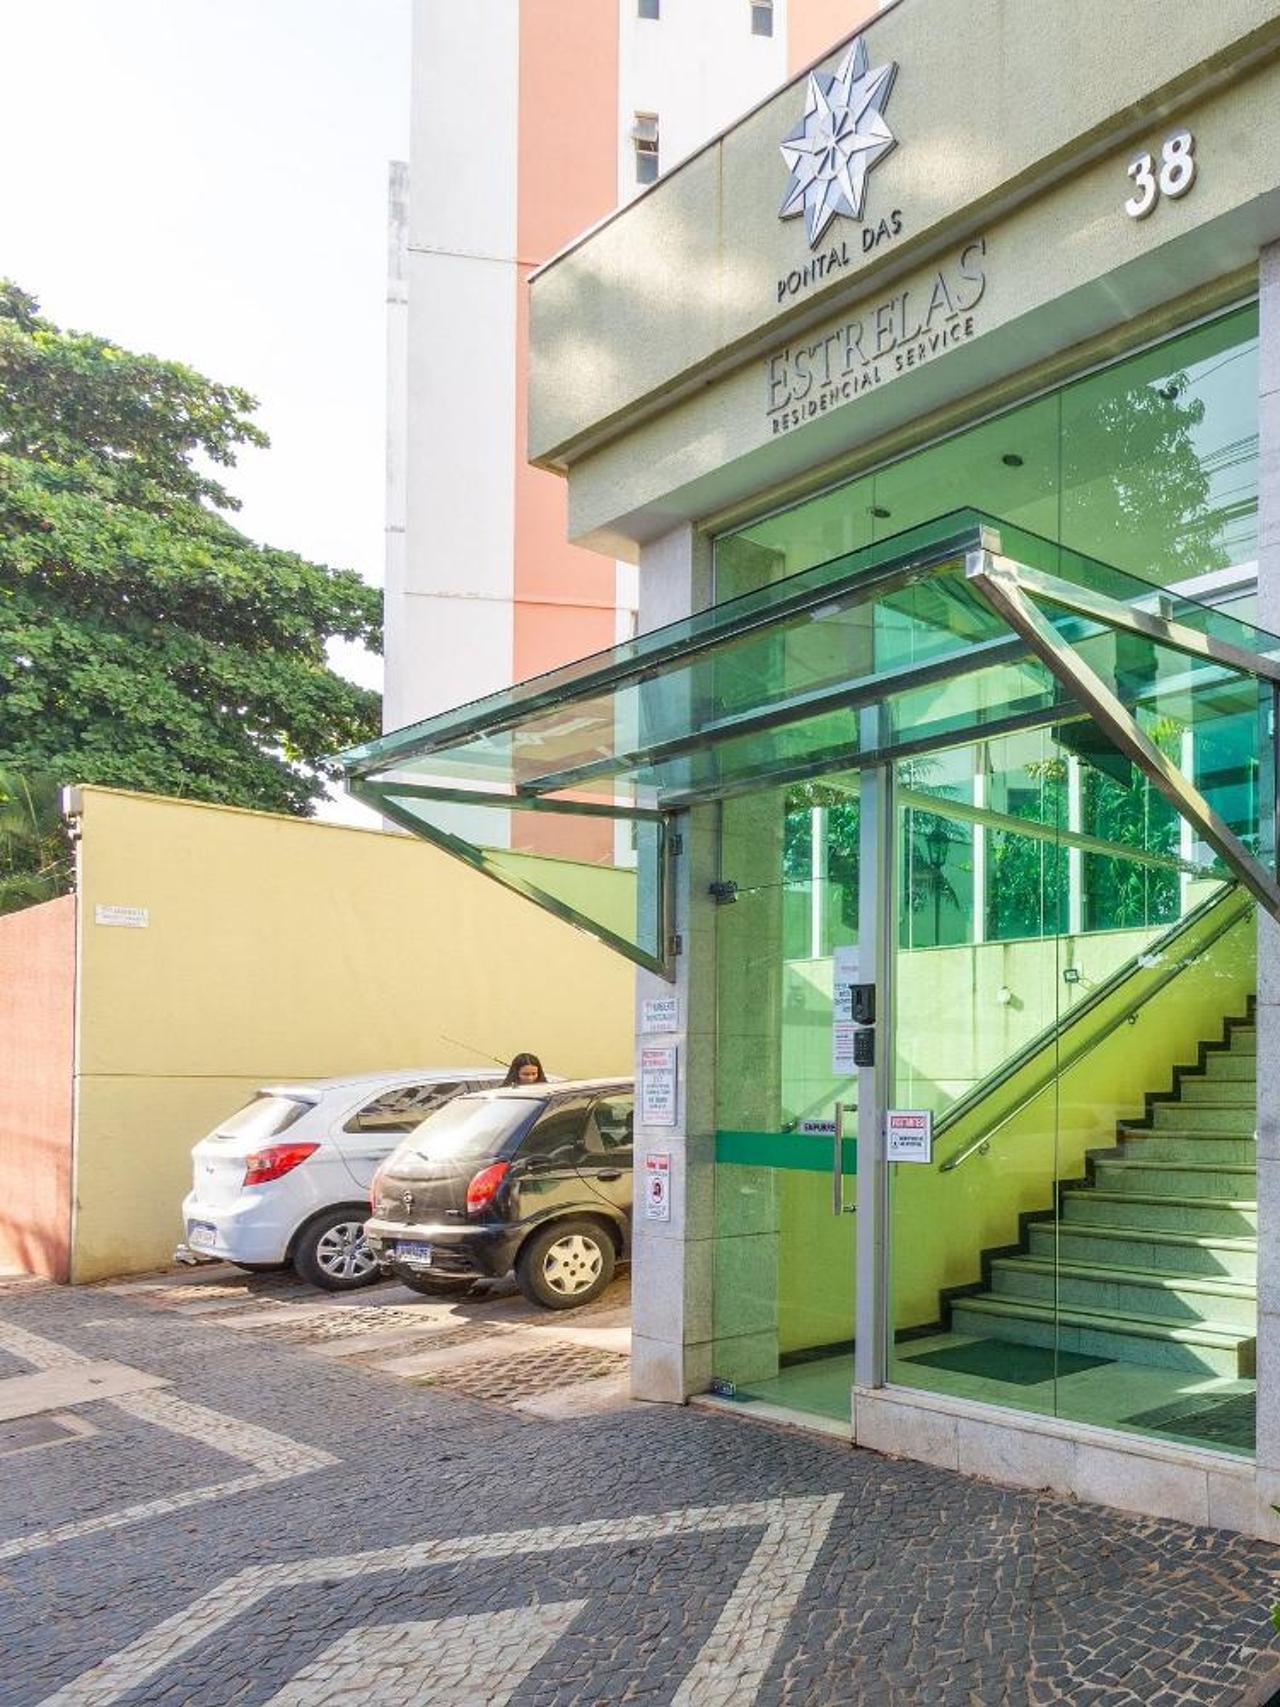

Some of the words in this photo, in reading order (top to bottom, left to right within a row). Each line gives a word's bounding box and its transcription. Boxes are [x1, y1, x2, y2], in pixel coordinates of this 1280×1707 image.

[1125, 129, 1196, 219] 38
[777, 241, 850, 303] PONTAL
[862, 209, 902, 253] DAS
[766, 237, 987, 416] ESTRELAS
[772, 365, 882, 434] RESIDENCIAL
[895, 316, 974, 371] SERVICE
